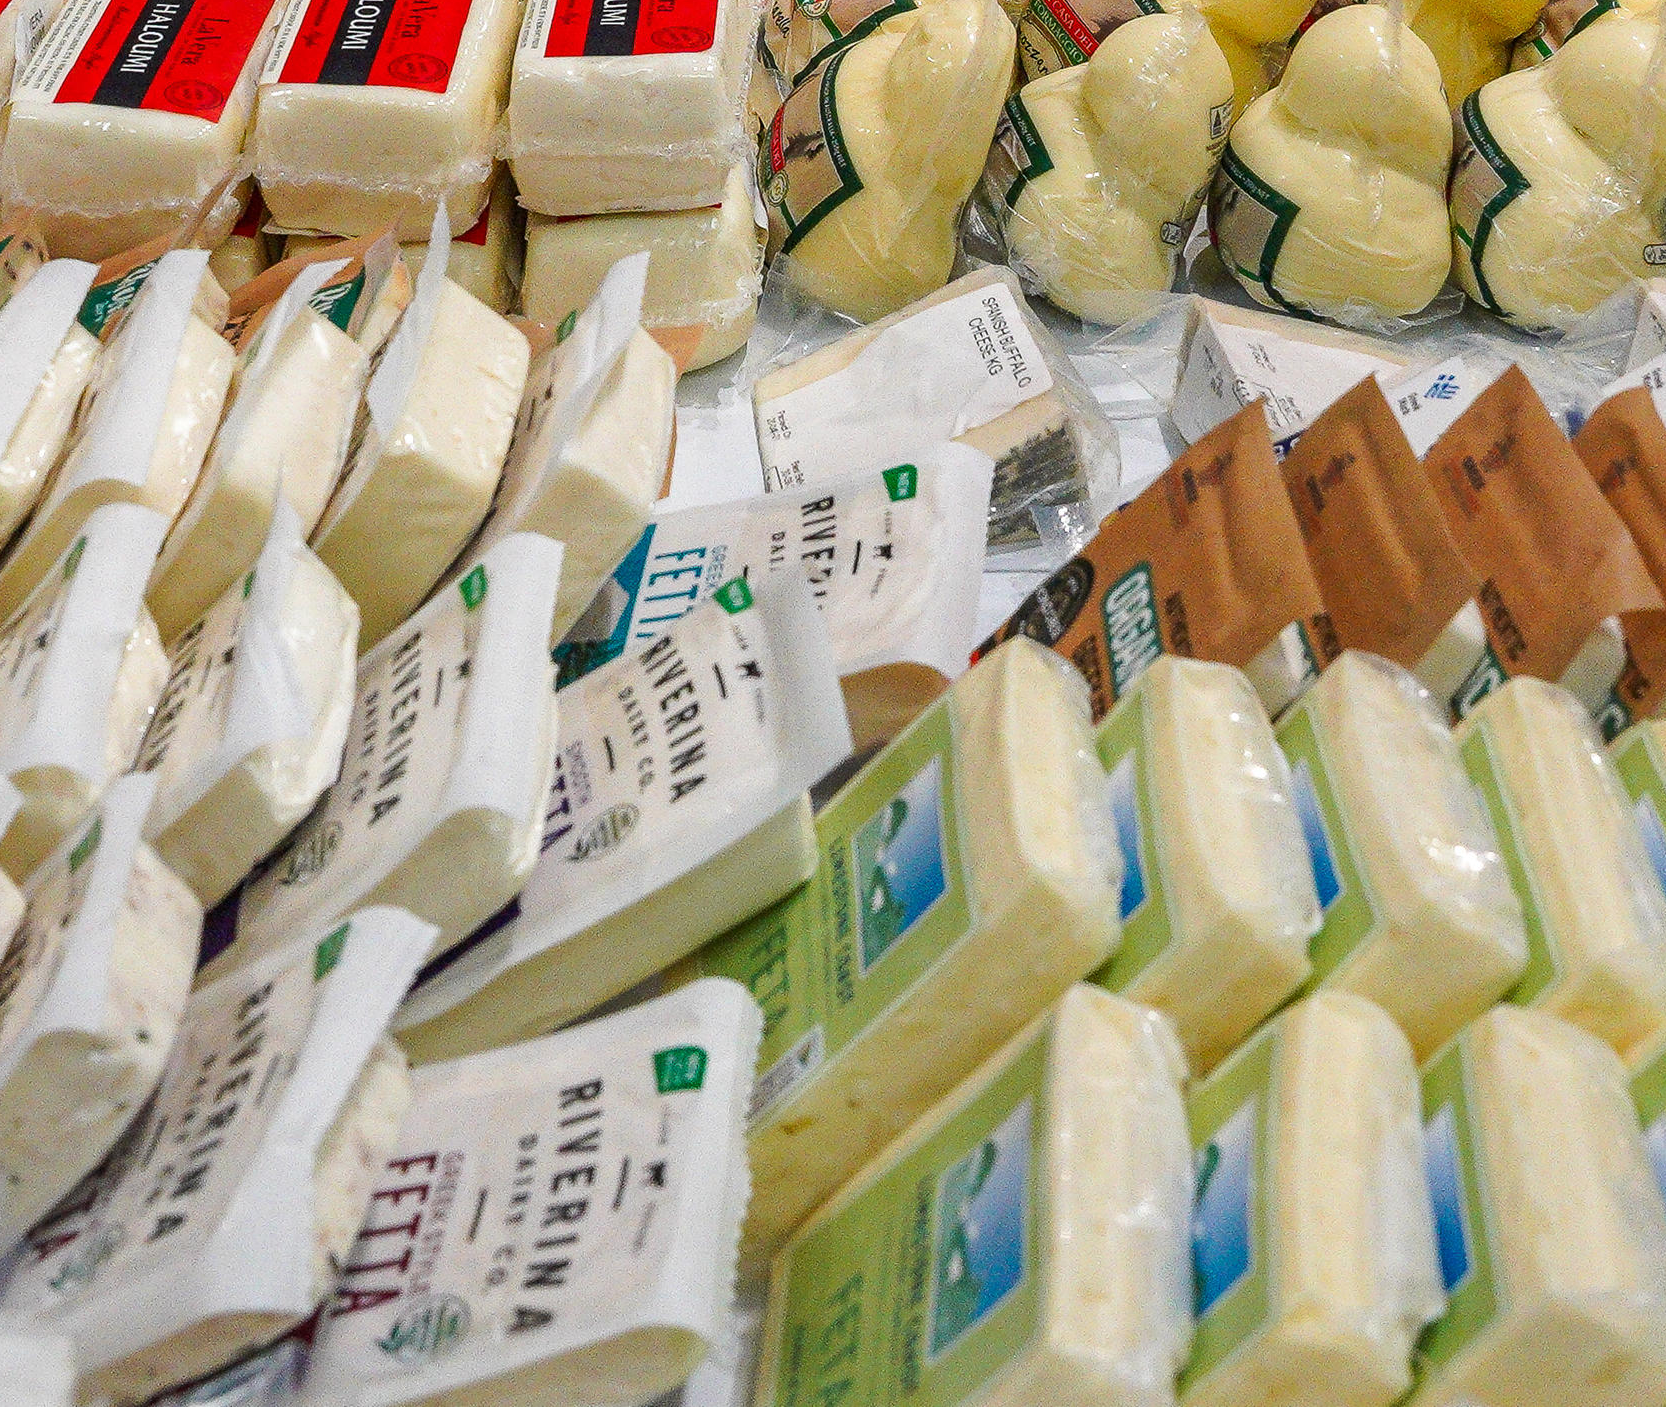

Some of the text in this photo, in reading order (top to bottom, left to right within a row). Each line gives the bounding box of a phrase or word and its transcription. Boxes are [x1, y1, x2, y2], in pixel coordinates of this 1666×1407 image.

[120, 3, 180, 73] HALOUMI
[967, 315, 1003, 376] CHEESE KG
[982, 296, 1031, 388] SPANISH BUFFALO
[1105, 565, 1161, 698] ORGAN
[367, 632, 422, 825] RIVERINA
[618, 686, 650, 749] DAIRY
[637, 633, 709, 803] RIVERINA
[337, 1151, 439, 1319] FETTA
[506, 1134, 538, 1226] DAIRY
[506, 1079, 604, 1336] RIVERINA
